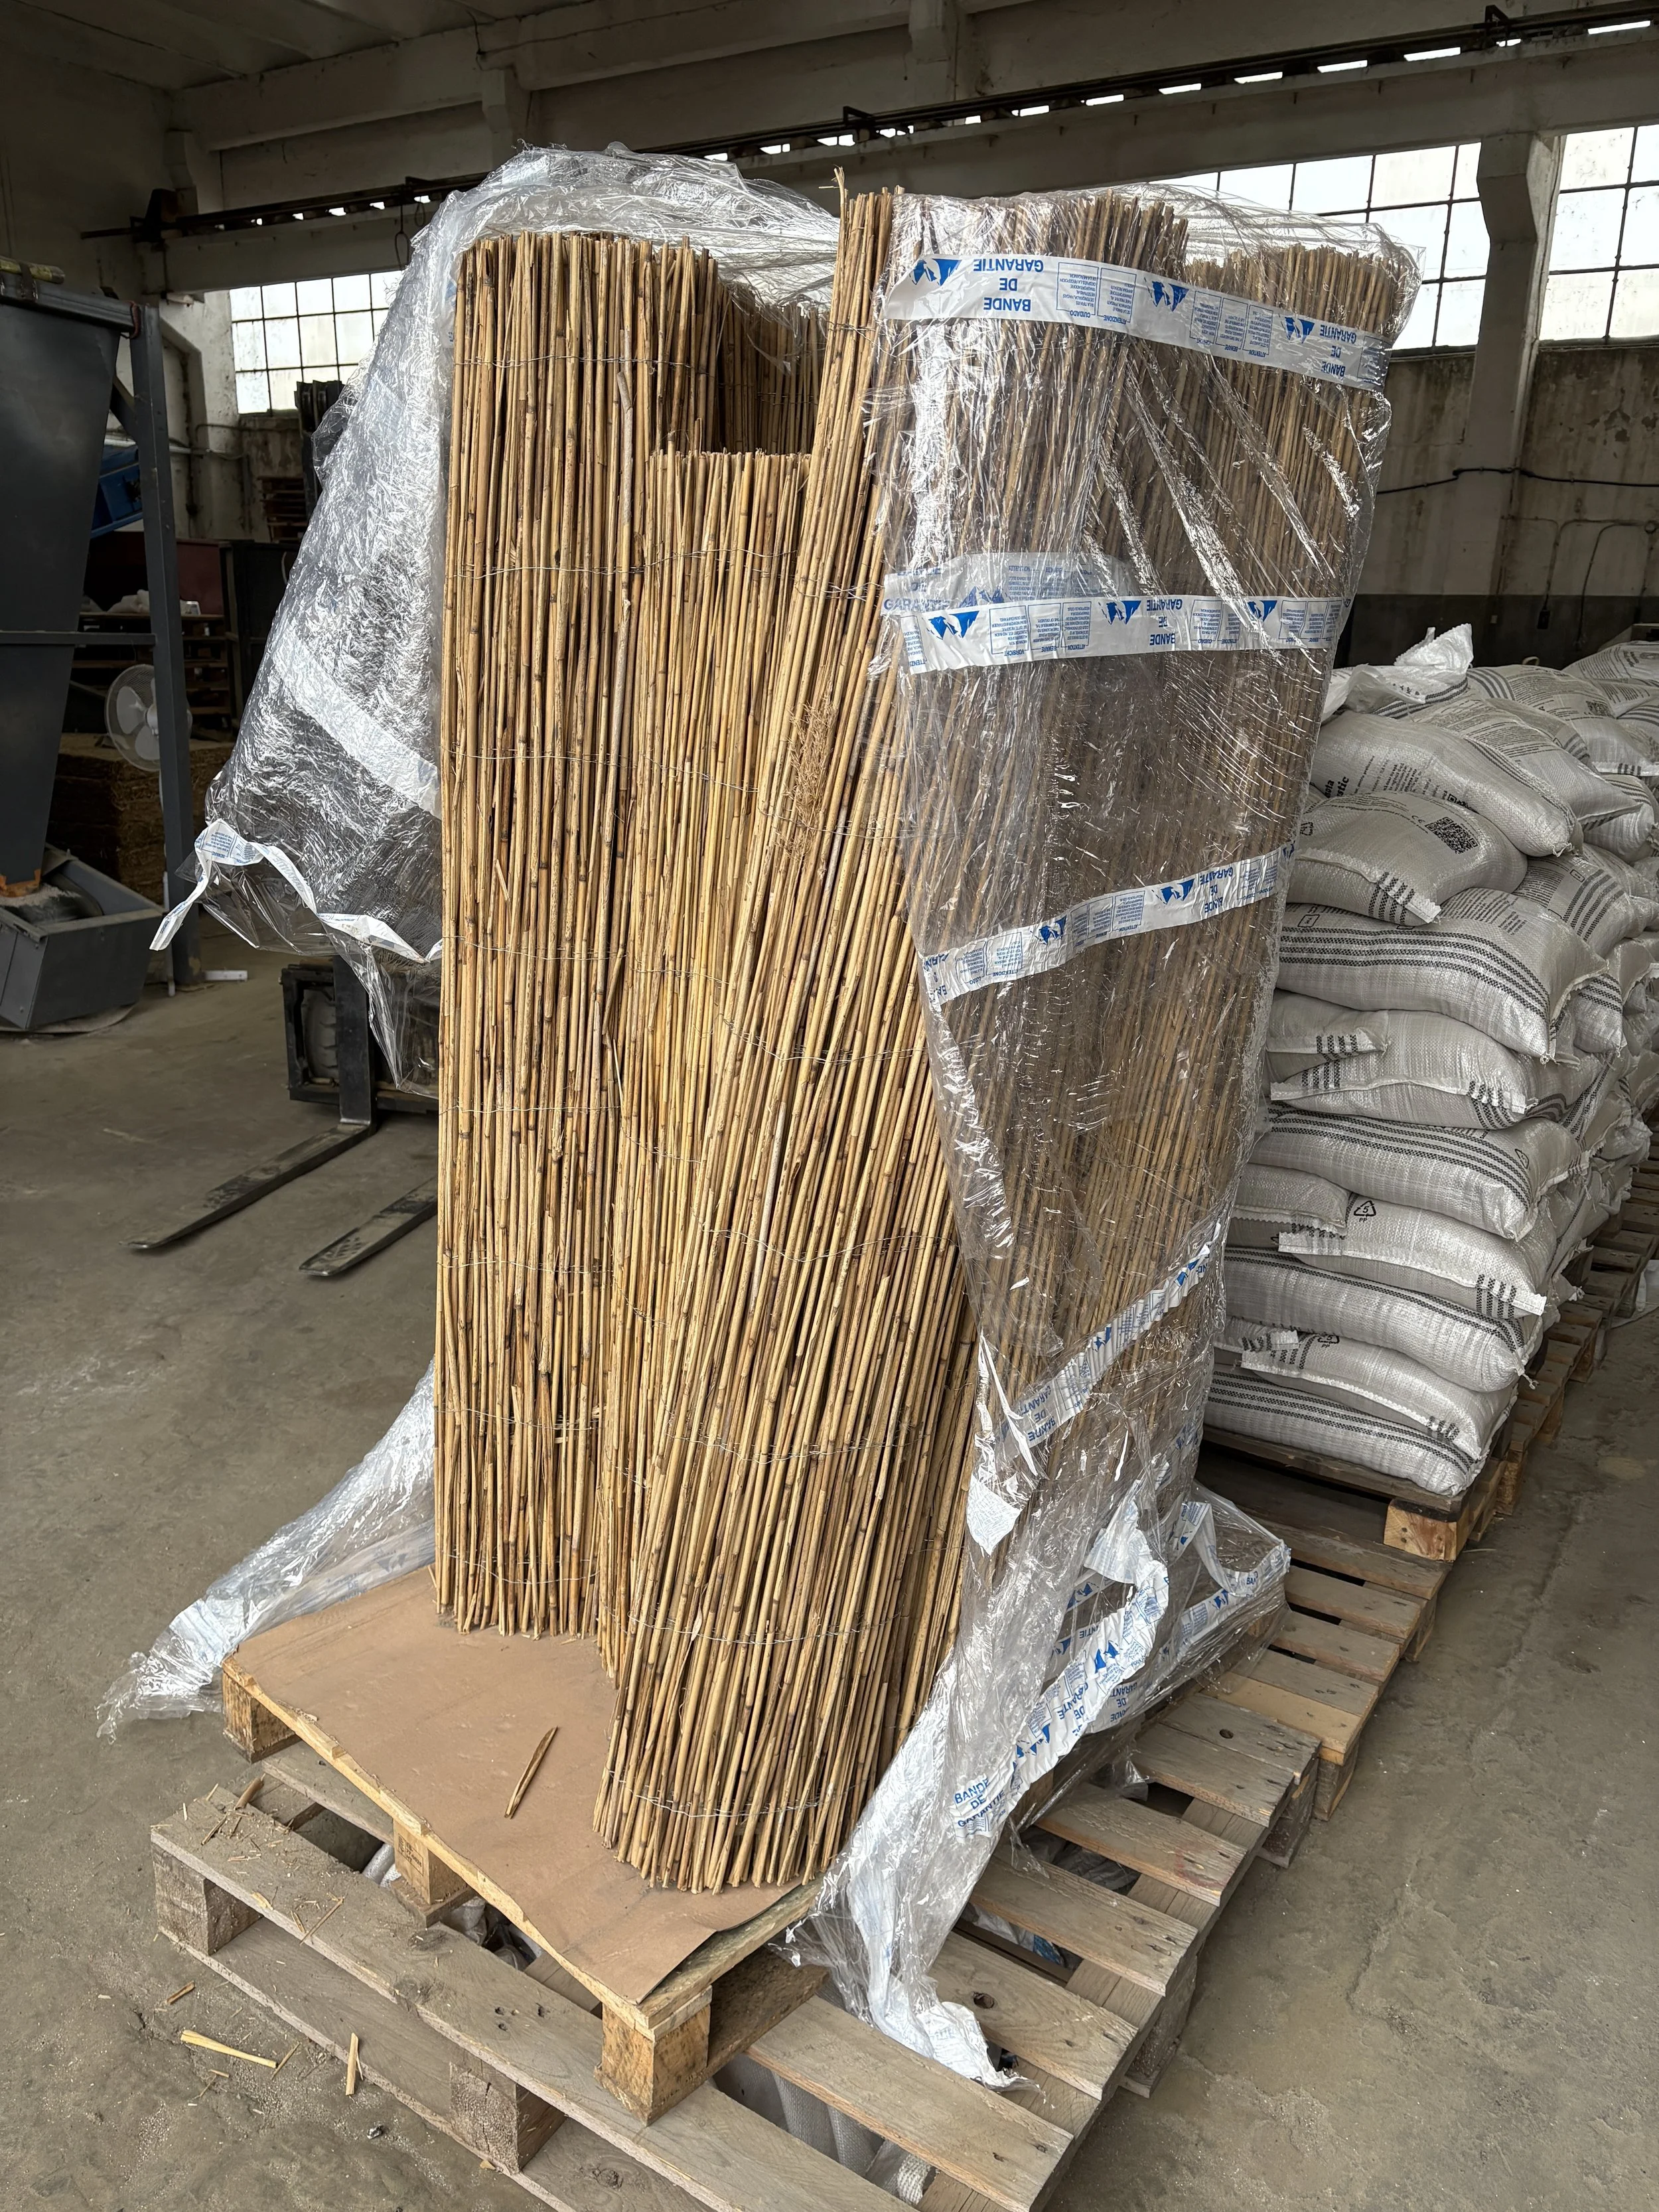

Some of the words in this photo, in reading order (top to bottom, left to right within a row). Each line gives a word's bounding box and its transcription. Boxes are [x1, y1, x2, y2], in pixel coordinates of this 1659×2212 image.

[974, 259, 1043, 272] GARANTIE
[999, 278, 1017, 291] DE
[983, 297, 1031, 311] BANDE
[1320, 325, 1356, 344] GARANTIE
[1331, 346, 1341, 358] DE
[1321, 361, 1345, 377] BANDE
[1147, 599, 1182, 611] GARANTIE
[1158, 617, 1167, 627] DE
[1149, 632, 1175, 646] BANDE
[1200, 867, 1233, 885] GARANTIE
[1210, 885, 1217, 895] DE
[1034, 1409, 1046, 1423] DE
[1027, 1416, 1056, 1441] BANDE
[1116, 1697, 1127, 1708] DE
[1074, 1706, 1086, 1720] DE
[954, 1777, 989, 1804] BANDE
[958, 1790, 1005, 1827] GARANTIE
[970, 1795, 986, 1809] DE
